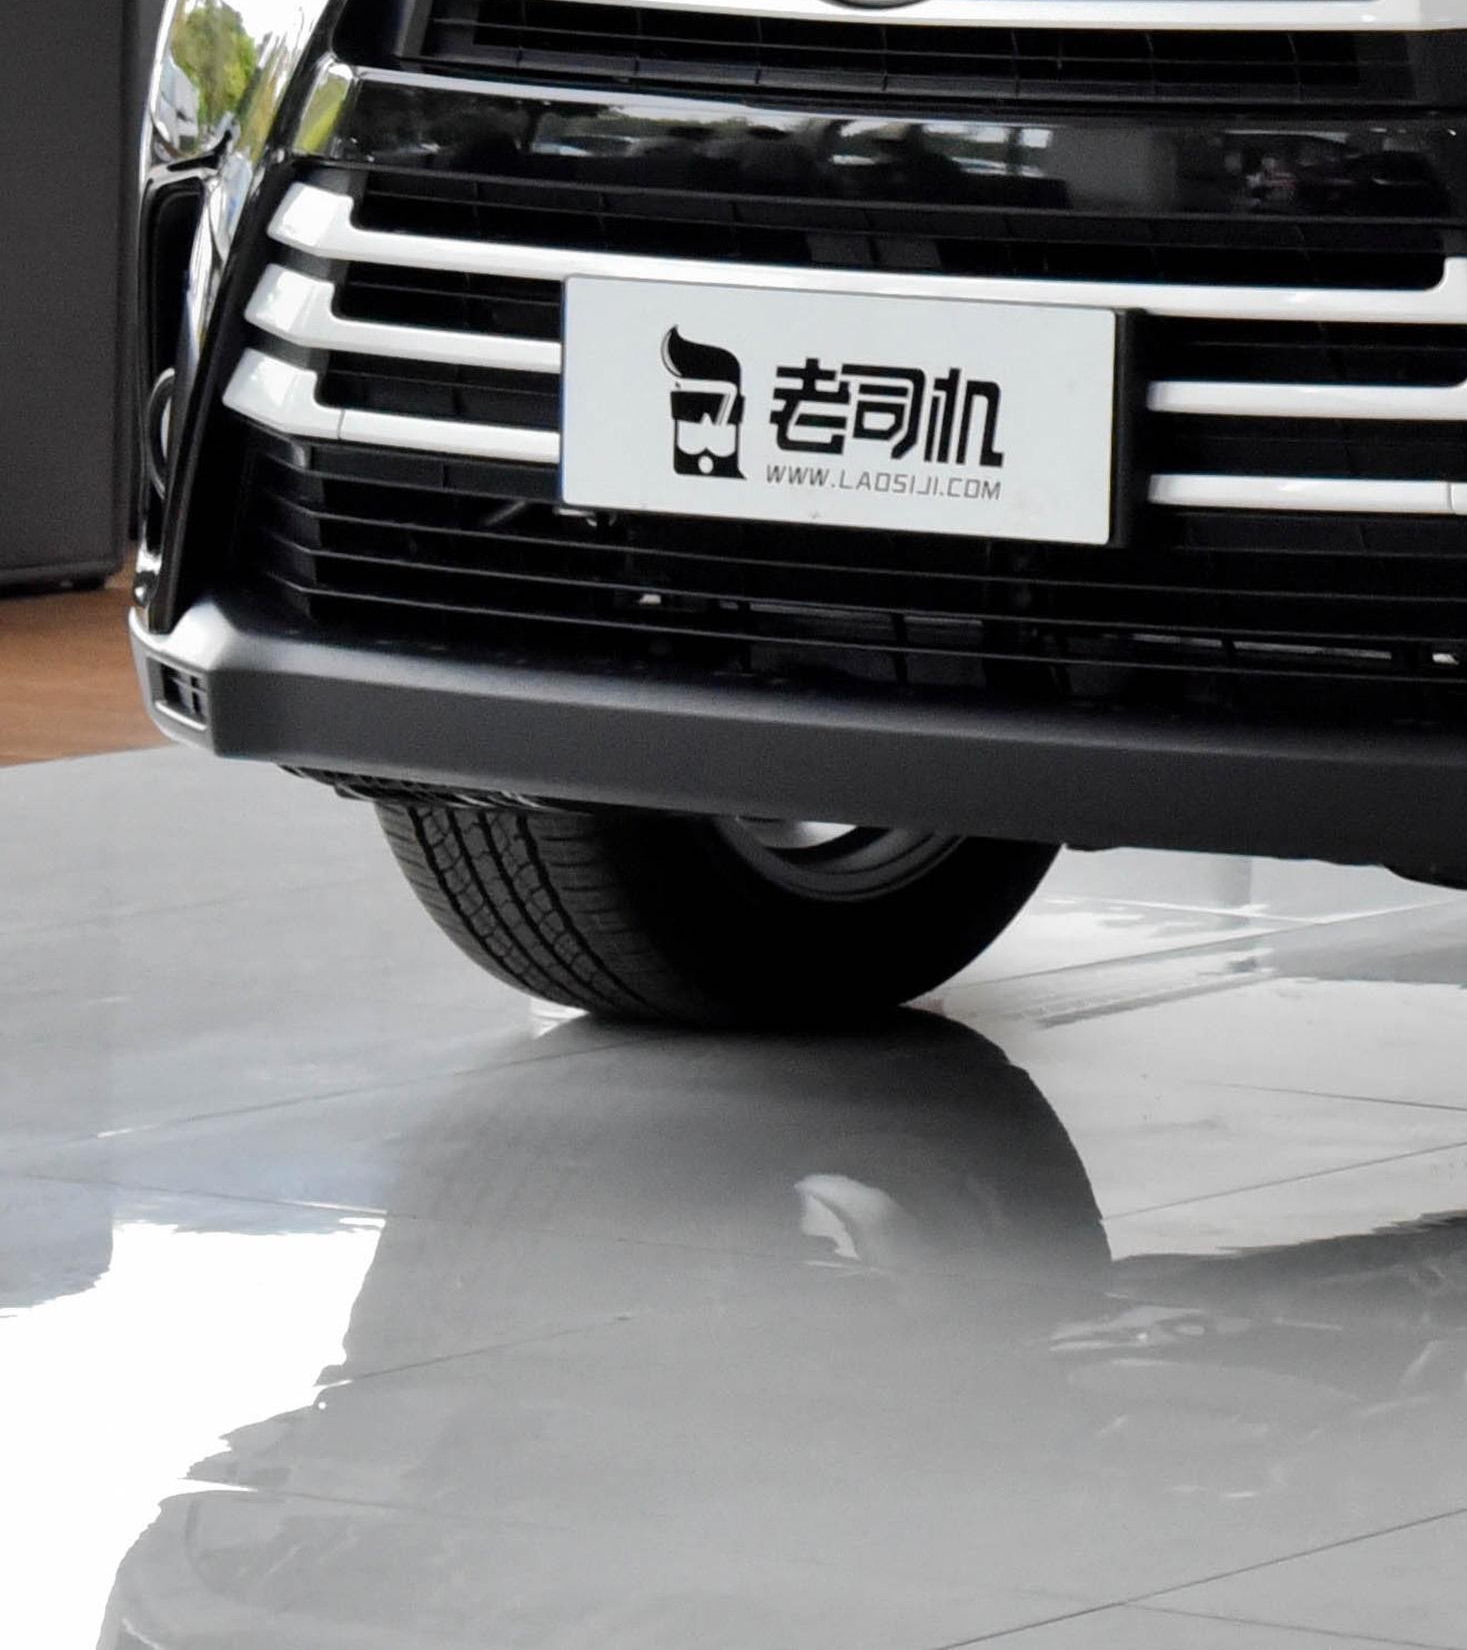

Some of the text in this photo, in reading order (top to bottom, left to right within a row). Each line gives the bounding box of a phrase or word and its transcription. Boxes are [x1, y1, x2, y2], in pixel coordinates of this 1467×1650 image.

[769, 358, 1004, 468] 老司机
[766, 463, 1003, 502] WWW.LAOSIJI.COM
